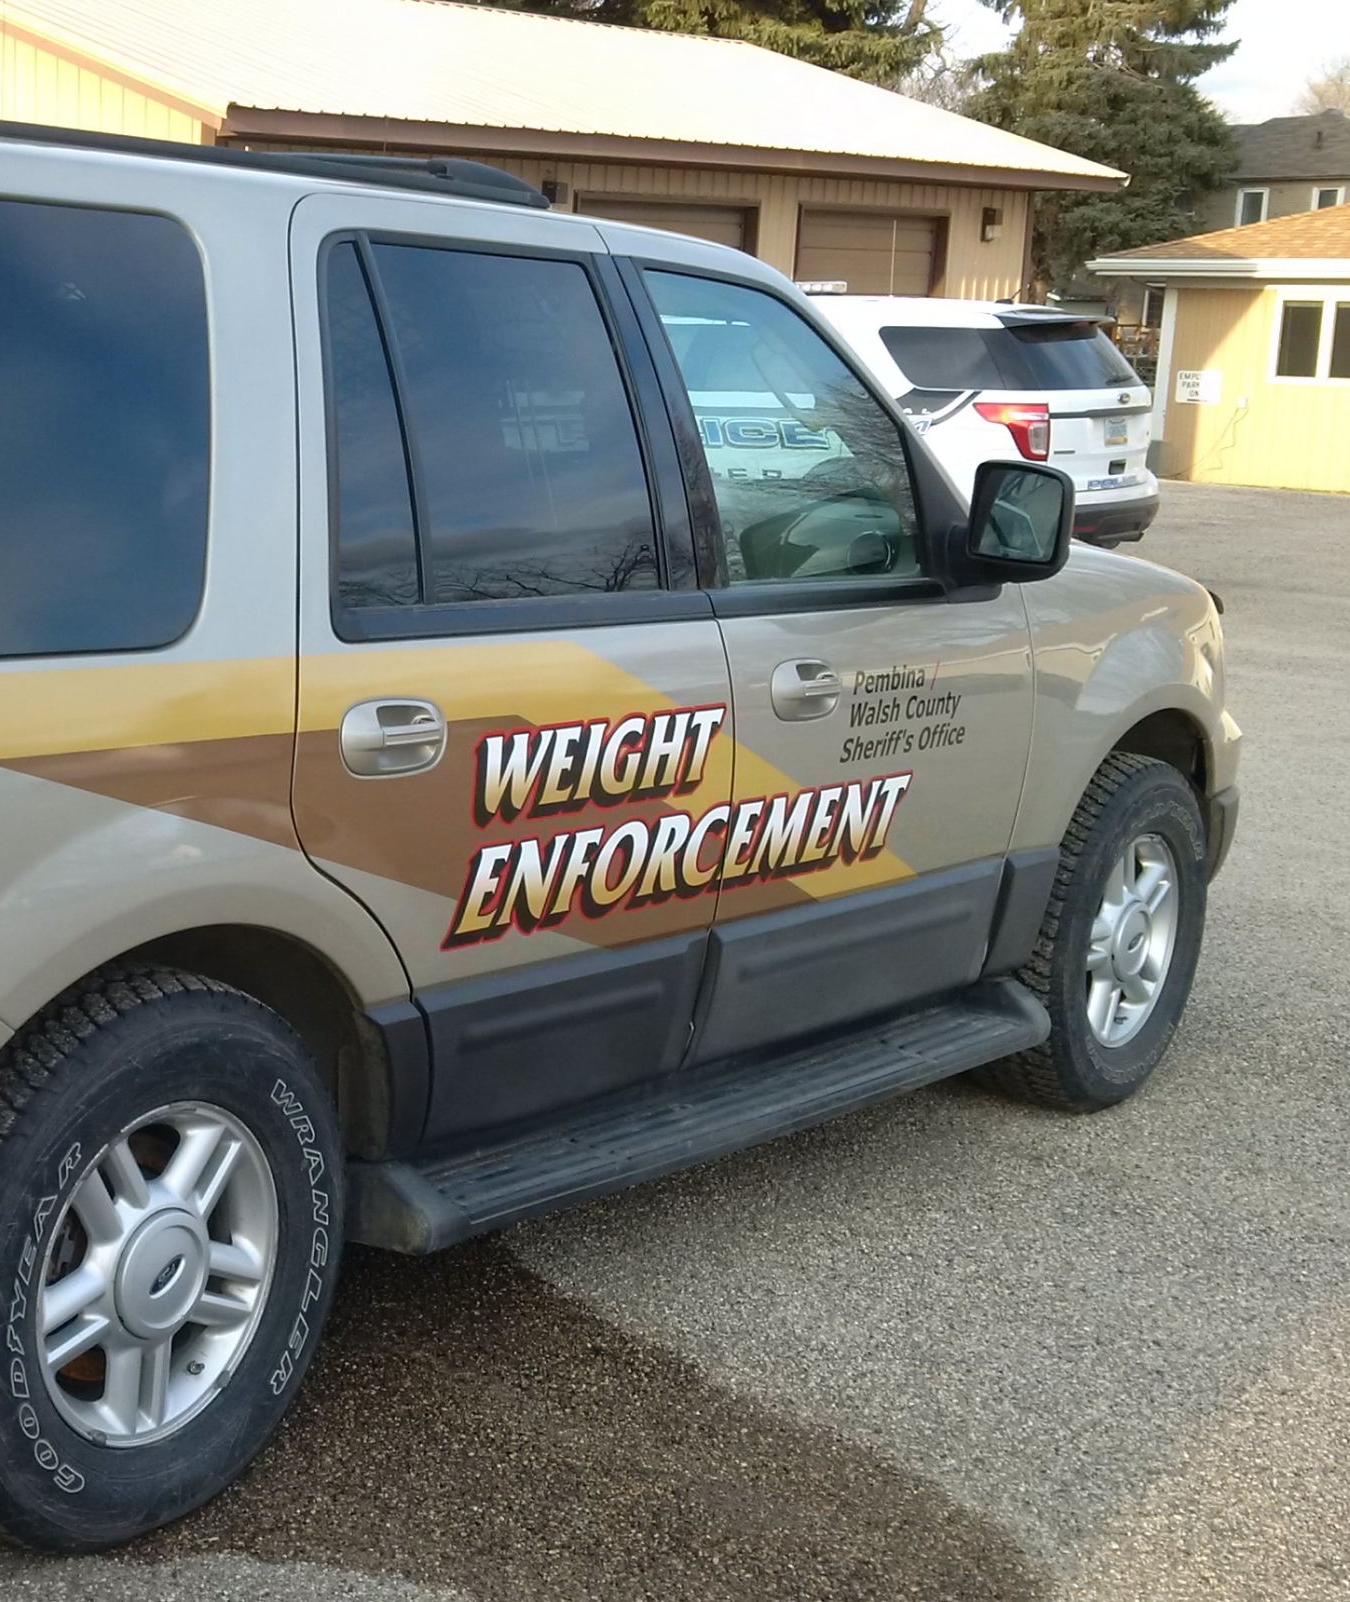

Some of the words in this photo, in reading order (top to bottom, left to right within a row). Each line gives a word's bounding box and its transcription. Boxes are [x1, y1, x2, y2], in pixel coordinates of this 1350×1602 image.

[850, 697, 901, 728] Walsh
[905, 691, 962, 719] County
[852, 664, 926, 695] Pembina
[474, 703, 727, 826] WEIGHT
[839, 729, 915, 763] Sheriff's
[917, 723, 966, 751] Office
[444, 772, 913, 947] ENFORCEMENT
[269, 1079, 331, 1397] WRANGLER
[6, 1141, 86, 1494] GOODYEAR
